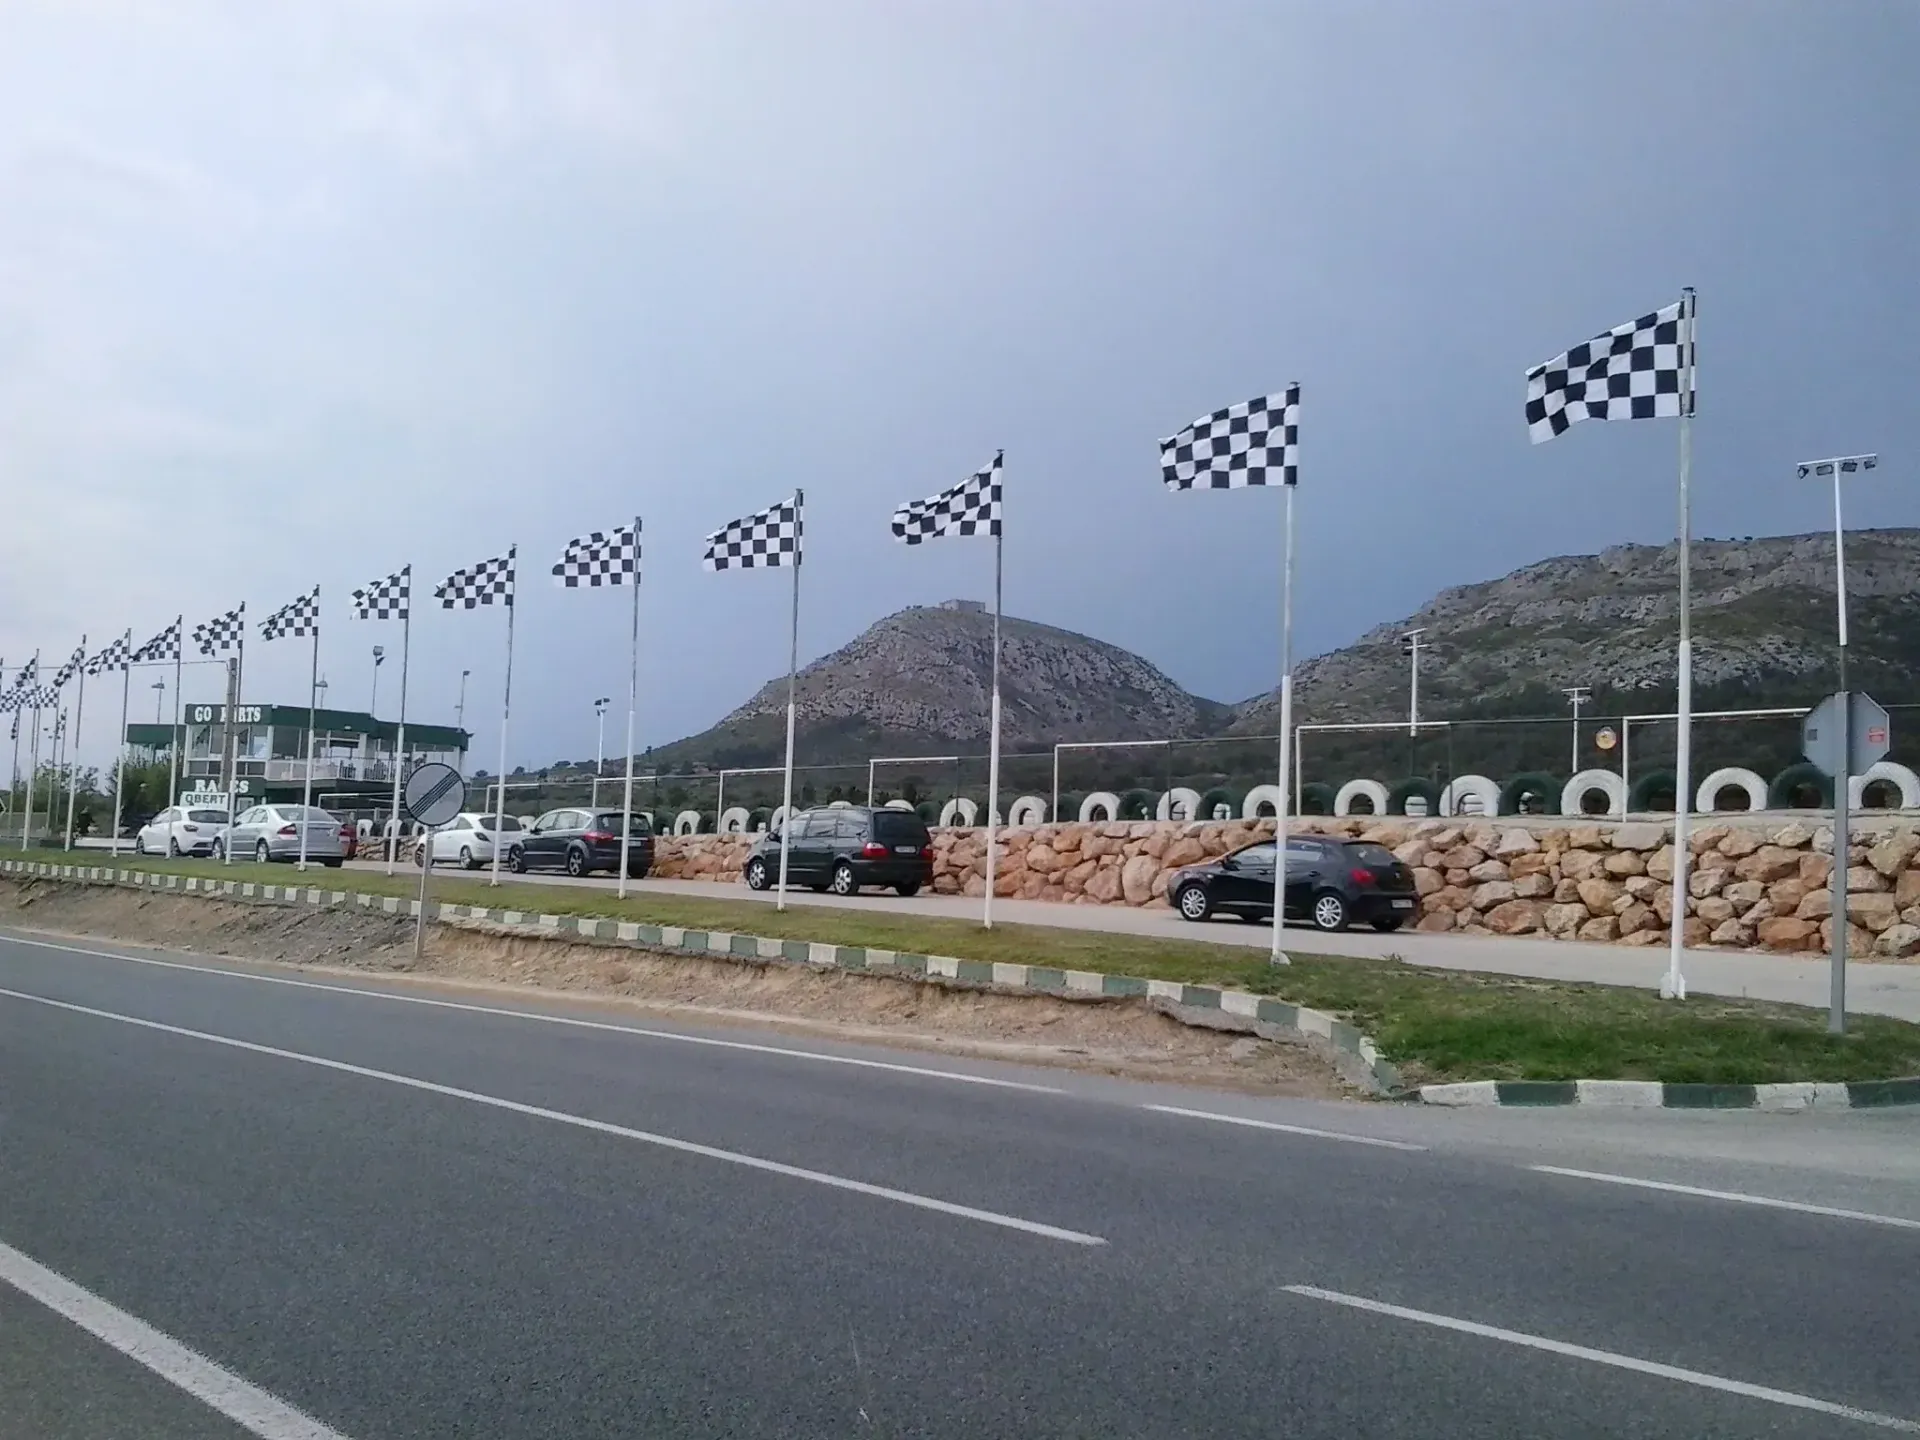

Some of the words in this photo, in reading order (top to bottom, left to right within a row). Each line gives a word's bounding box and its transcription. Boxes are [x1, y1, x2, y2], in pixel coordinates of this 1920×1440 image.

[195, 706, 212, 722] GO
[220, 706, 261, 723] KRTS
[195, 779, 249, 793] RAES
